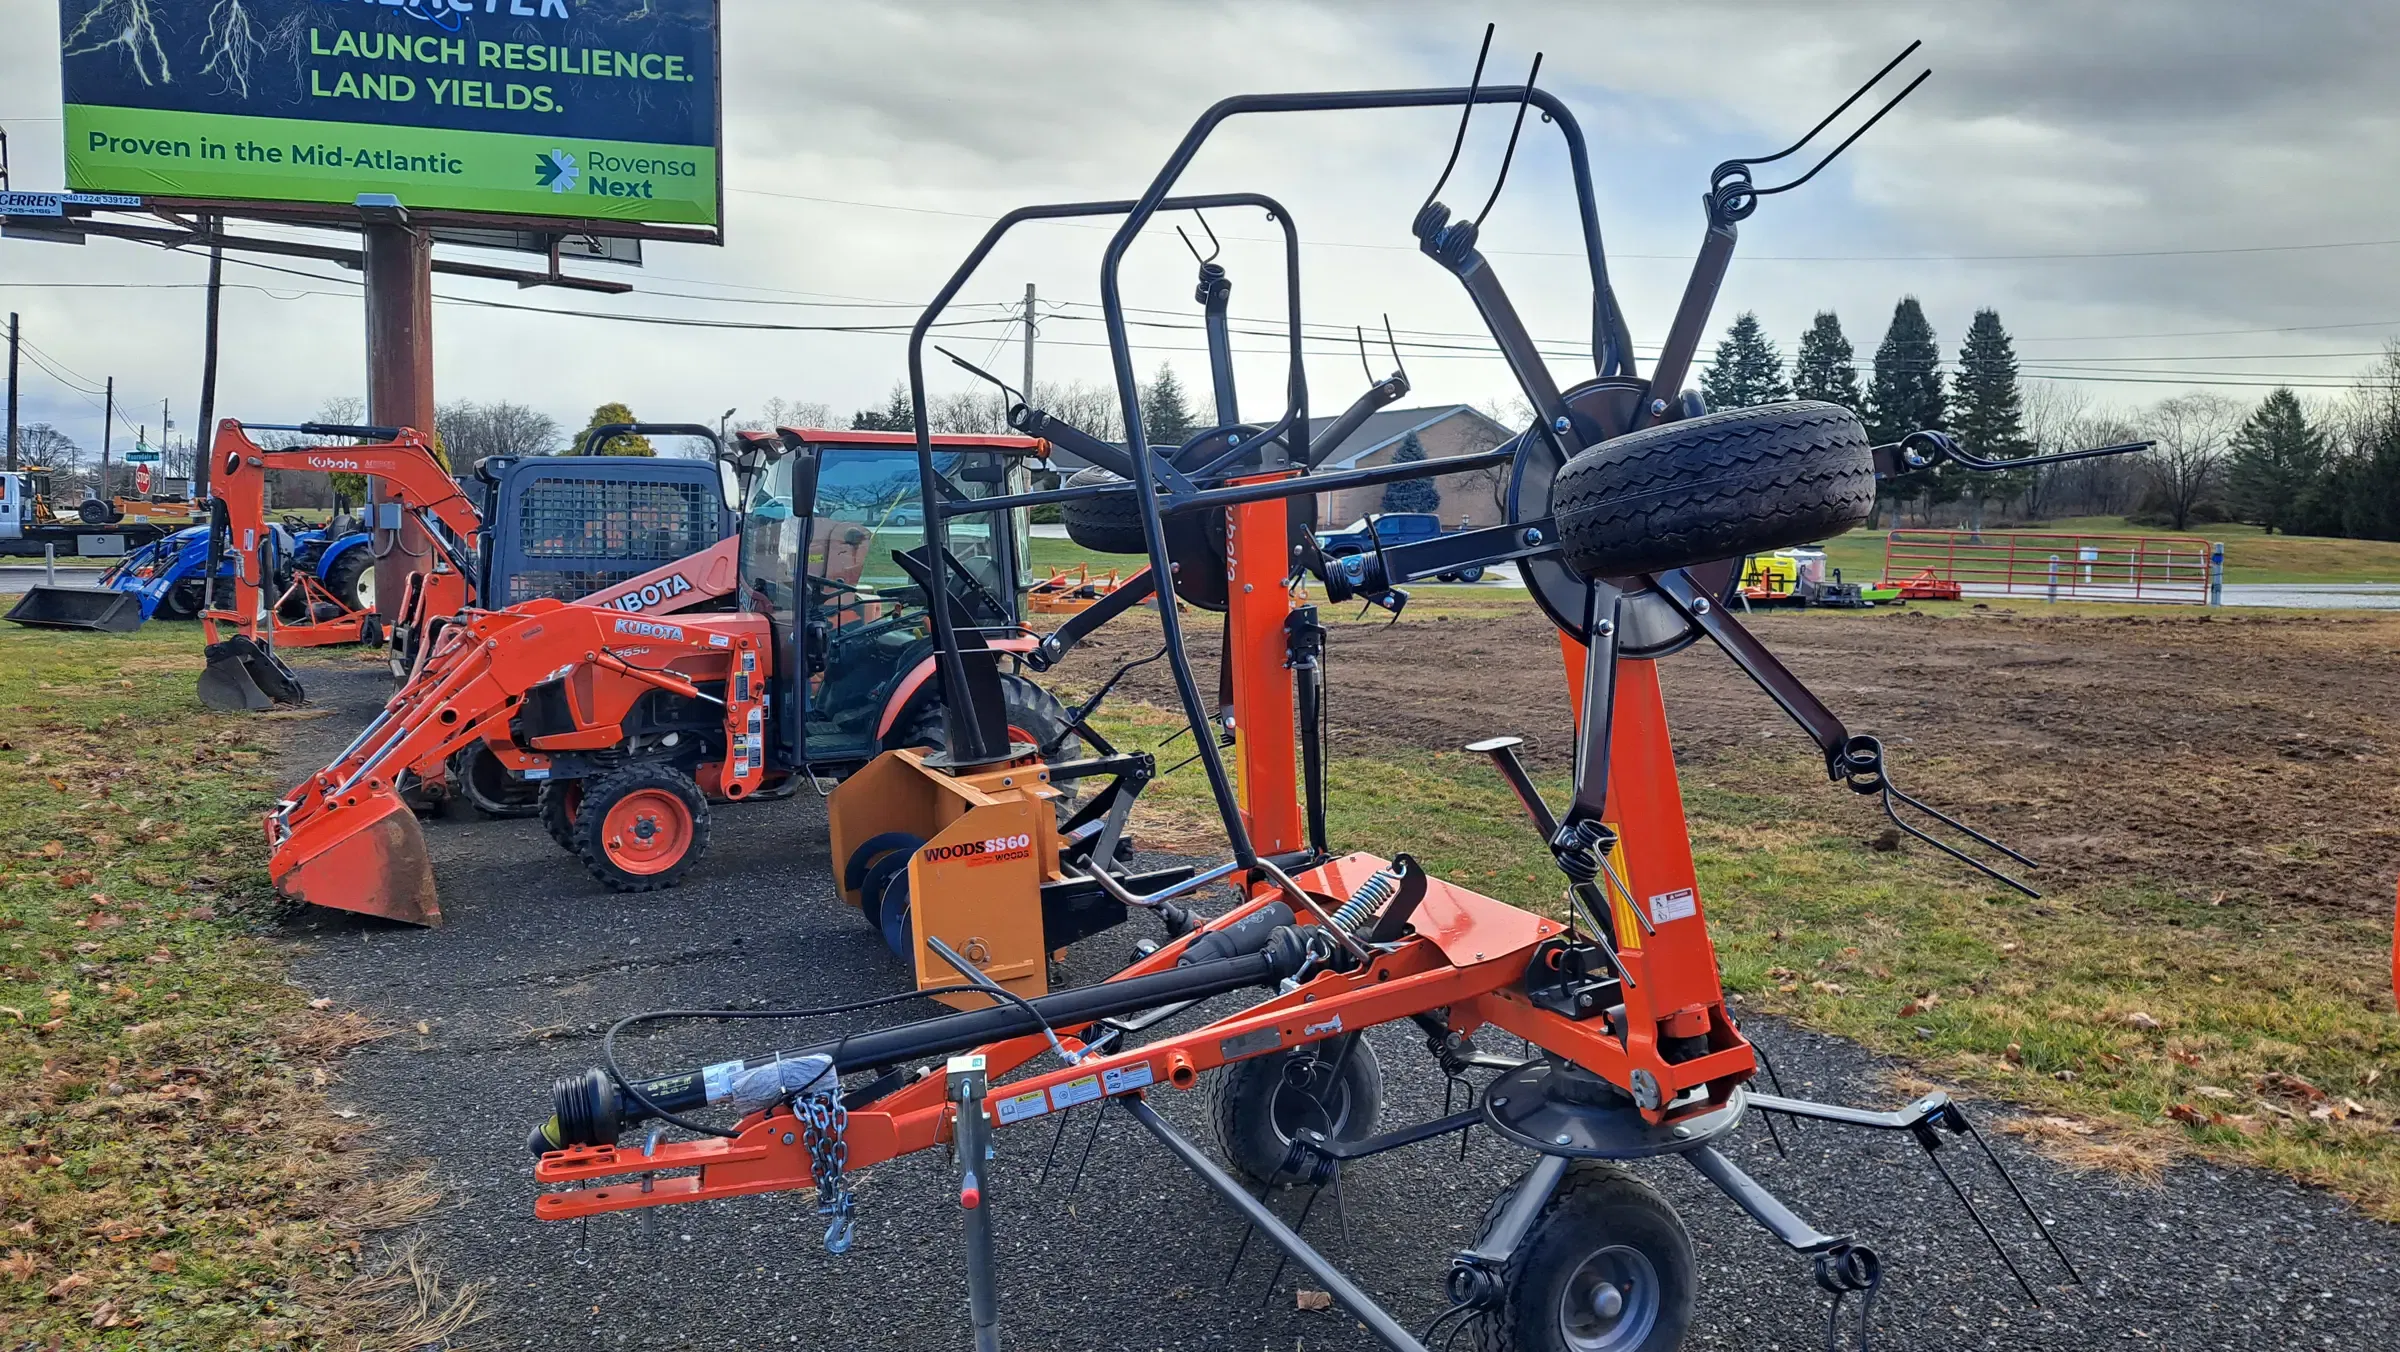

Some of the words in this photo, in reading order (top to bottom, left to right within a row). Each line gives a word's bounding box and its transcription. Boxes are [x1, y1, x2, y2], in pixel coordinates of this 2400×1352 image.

[310, 28, 465, 65] LAUNCH
[478, 40, 694, 82] RESILIENCE.
[310, 69, 416, 102] LAND
[426, 77, 564, 113] YIELDS.
[88, 131, 191, 158] Proven
[200, 137, 226, 160] in
[235, 141, 283, 163] the
[292, 144, 463, 175] Mid-Atlantic
[588, 151, 696, 177] Rovensa
[588, 176, 653, 199] Next
[308, 456, 358, 469] Kubota
[137, 472, 149, 484] STOP
[1225, 504, 1238, 582] ubota
[603, 574, 691, 612] UBOTA
[615, 618, 684, 642] KUBOTA
[607, 645, 650, 659] 2650
[995, 850, 1029, 861] WOODS
